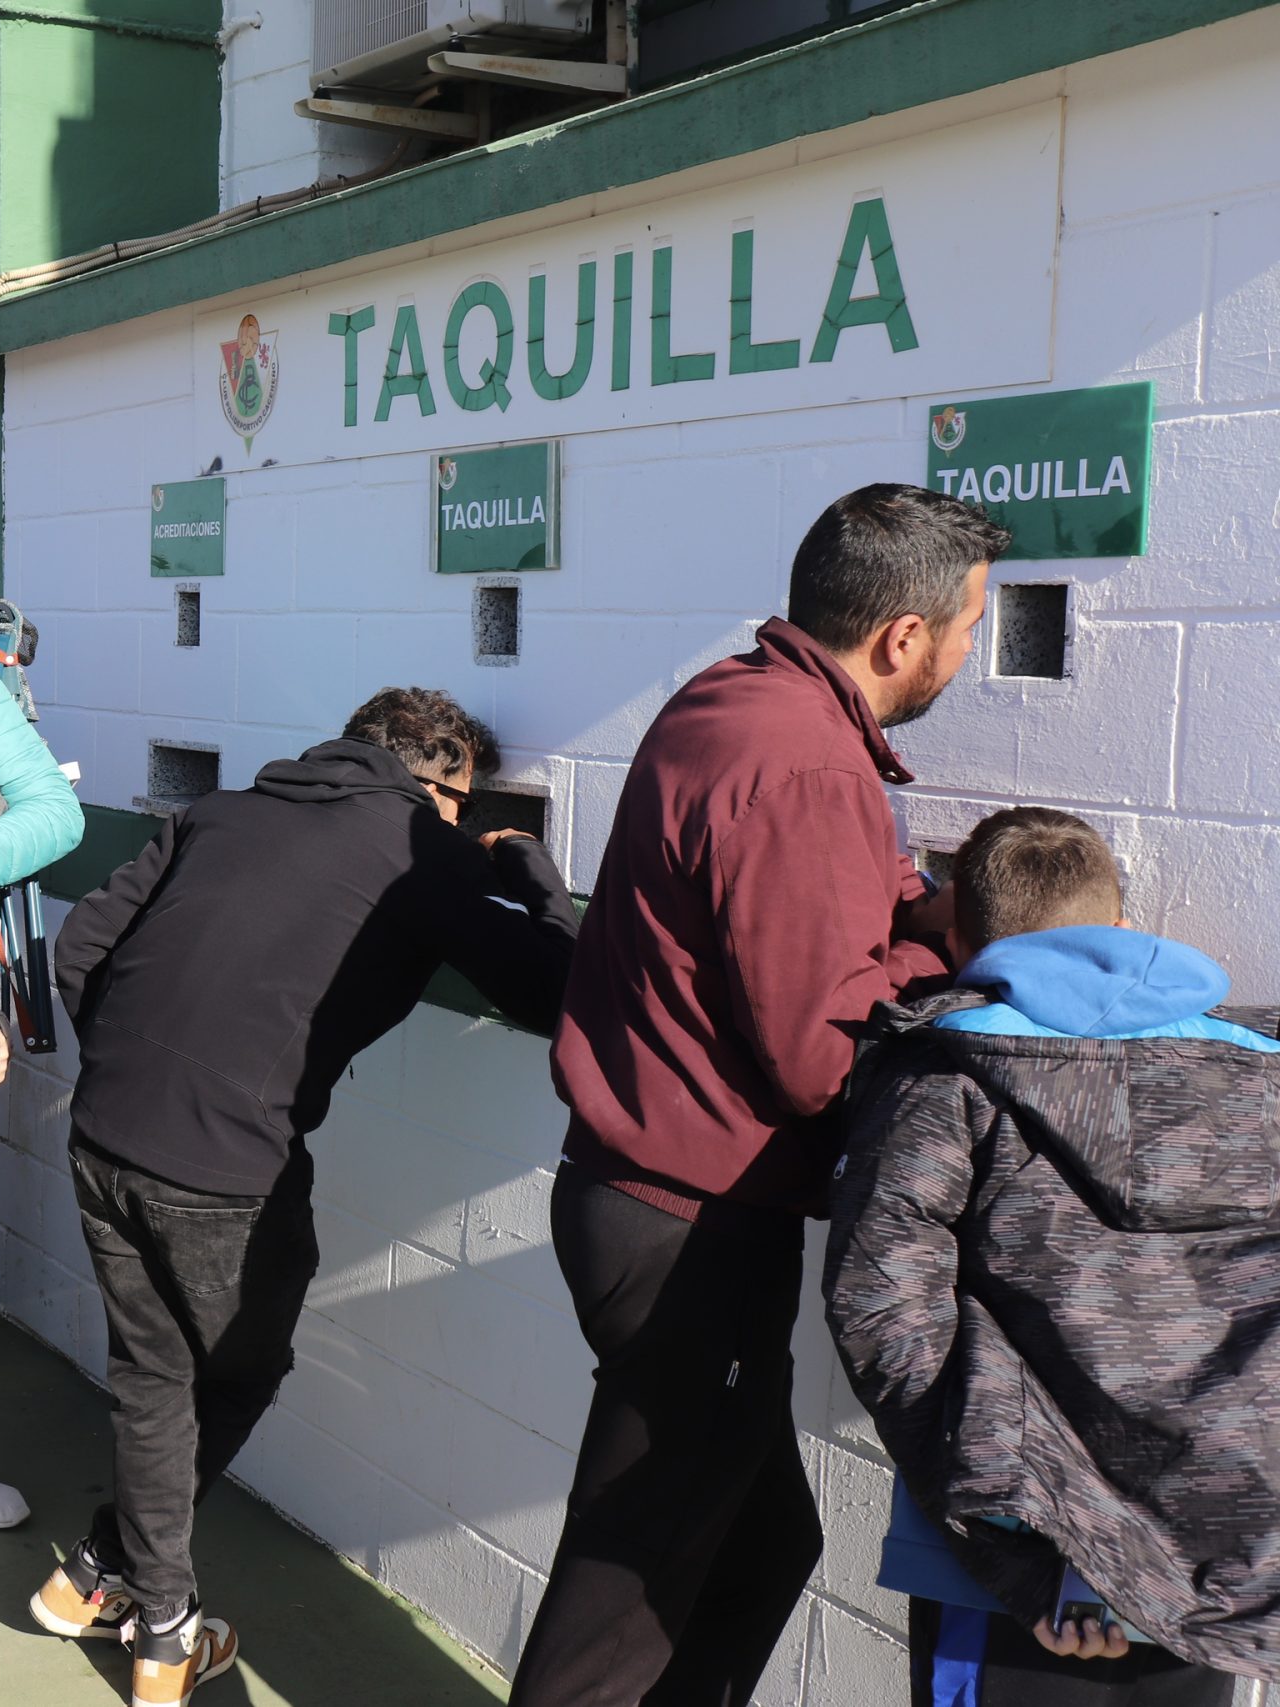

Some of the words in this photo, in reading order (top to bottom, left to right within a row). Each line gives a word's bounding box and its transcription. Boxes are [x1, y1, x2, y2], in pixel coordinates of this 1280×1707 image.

[328, 198, 919, 427] TAQUILLA
[936, 455, 1131, 503] TAQUILLA
[154, 521, 221, 538] ACREDITACIONES
[441, 495, 546, 531] TAQUILLA
